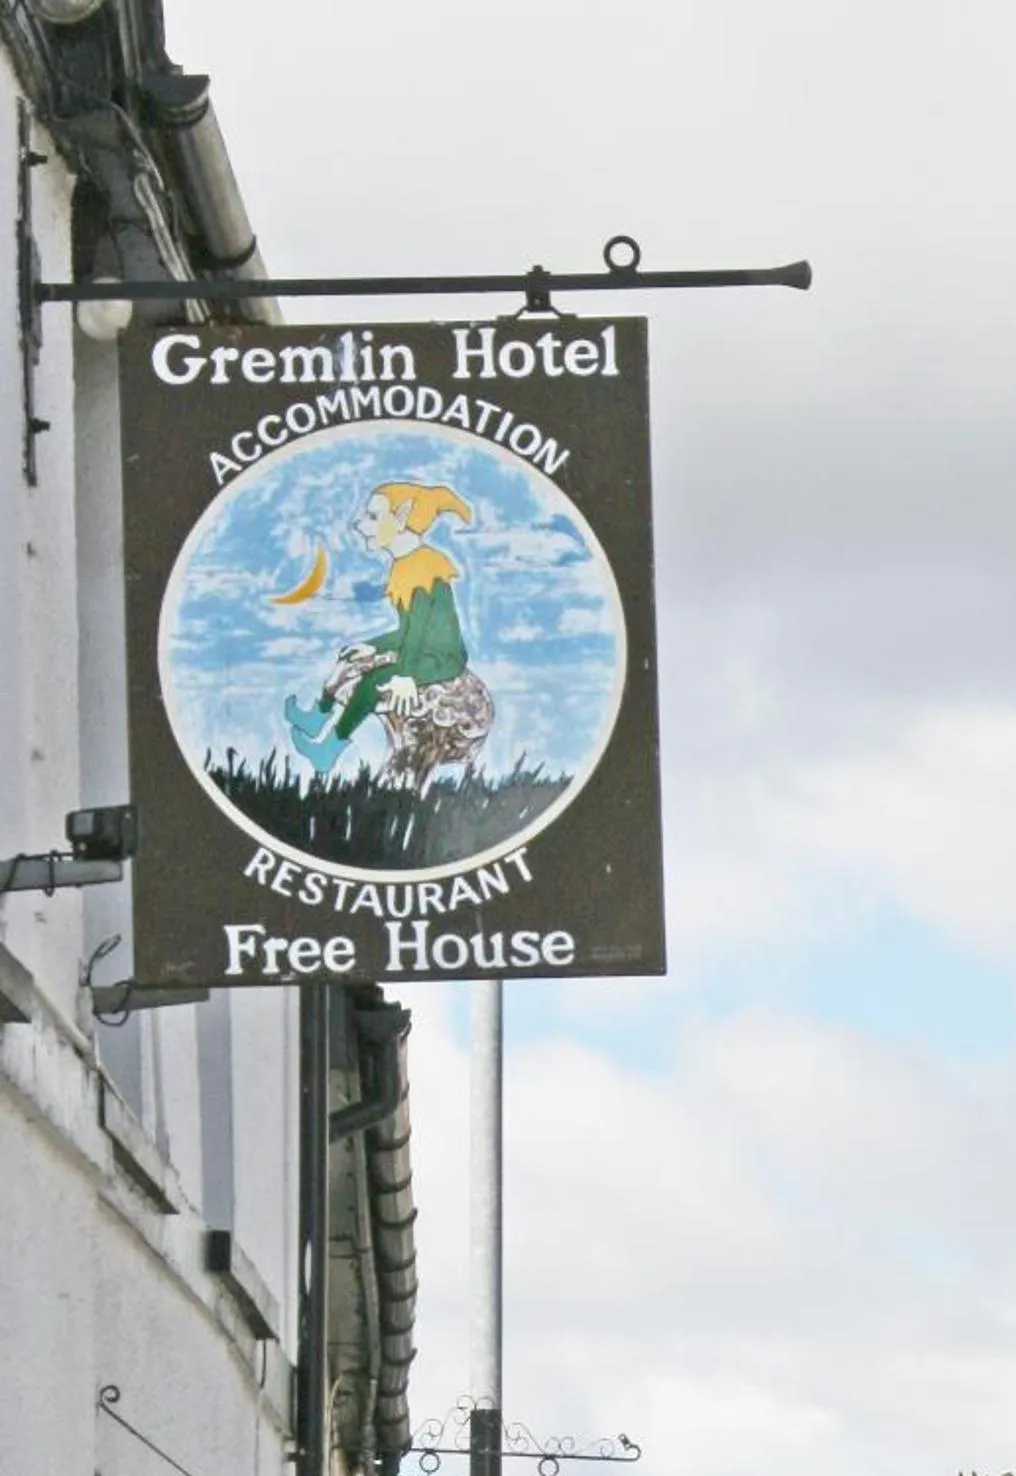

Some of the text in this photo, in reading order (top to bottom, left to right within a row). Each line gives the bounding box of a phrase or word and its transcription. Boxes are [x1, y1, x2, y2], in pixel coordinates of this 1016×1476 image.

[151, 327, 619, 386] Gremlin Hotel
[207, 384, 571, 486] ACCOMMODATION
[243, 847, 533, 917] RESTAURANT
[223, 919, 575, 975] Free House
